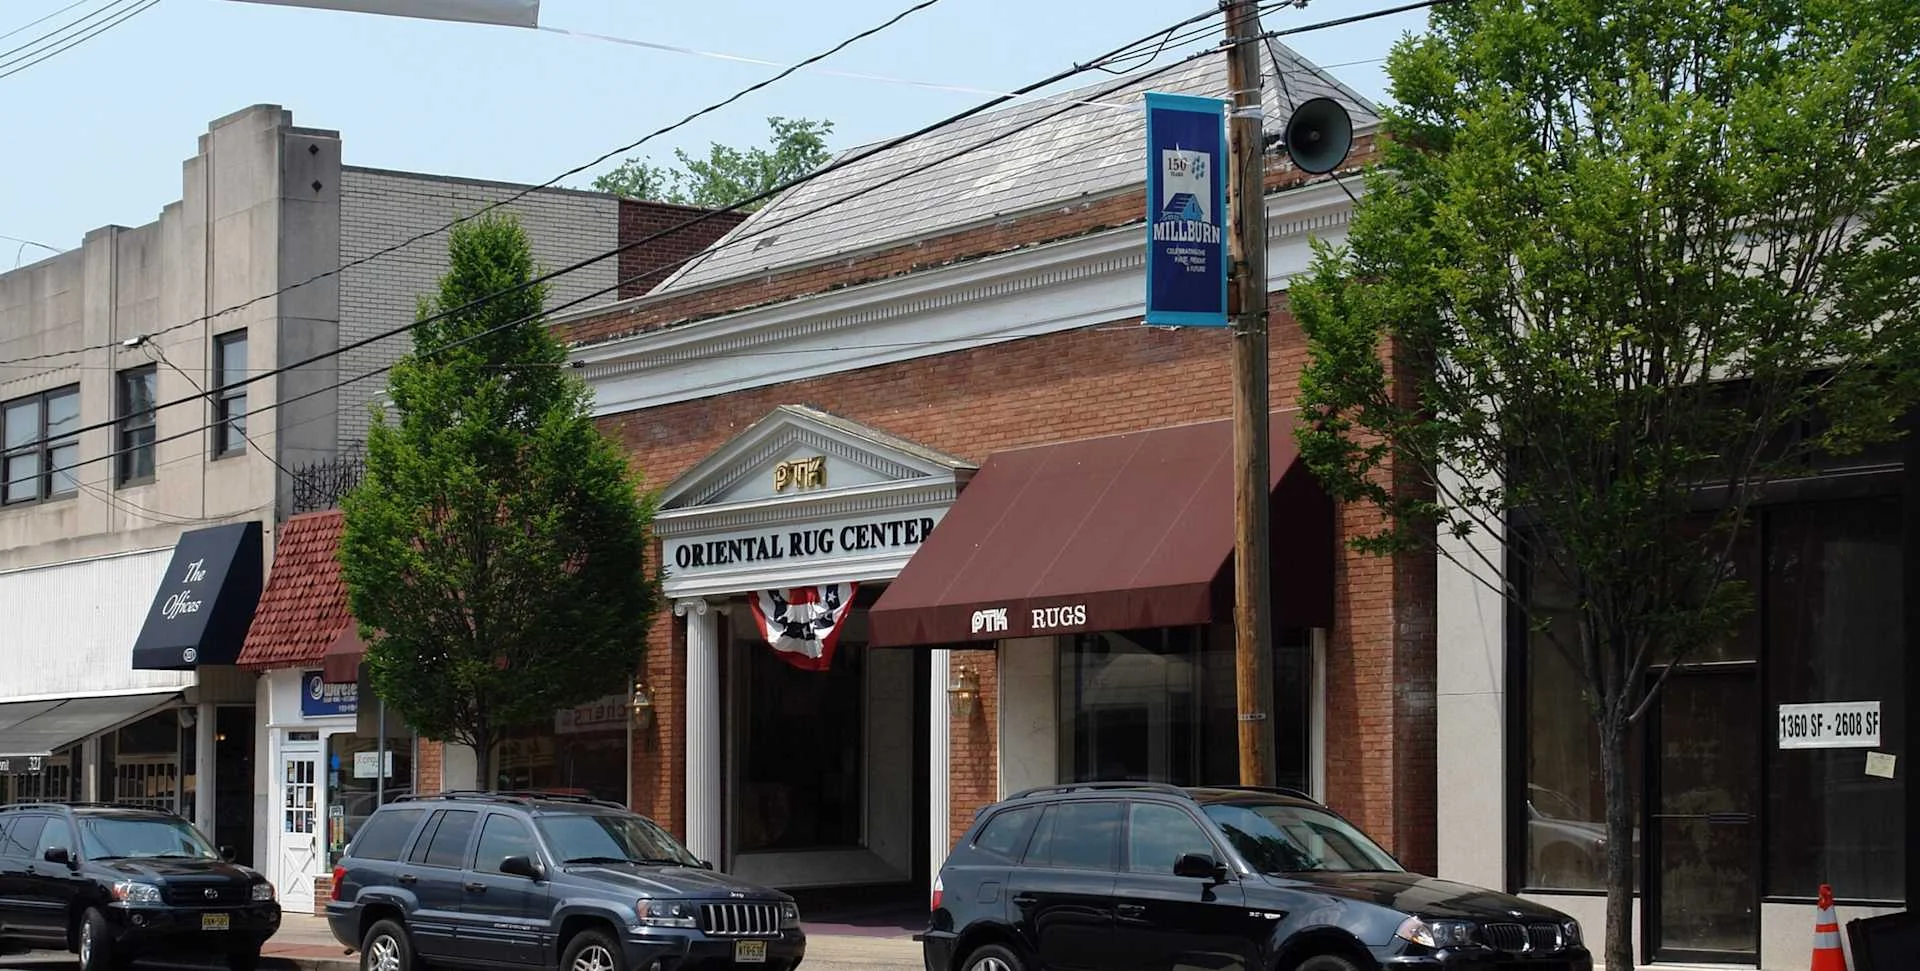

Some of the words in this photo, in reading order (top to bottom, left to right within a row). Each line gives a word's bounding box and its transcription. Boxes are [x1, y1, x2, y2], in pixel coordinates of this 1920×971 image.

[1168, 157, 1187, 171] 150
[1154, 221, 1220, 243] MILLBURN
[774, 456, 827, 491] PTK
[675, 534, 784, 568] ORIENTAL
[789, 528, 834, 557] RUG
[840, 517, 935, 551] CENTER
[182, 559, 206, 583] The
[162, 590, 201, 619] Offices
[971, 607, 1008, 633] PTK
[1031, 604, 1087, 629] RUGS
[1781, 714, 1807, 738] 1360
[1811, 713, 1823, 737] SF
[1835, 712, 1862, 736] 2608
[1866, 711, 1879, 735] SF
